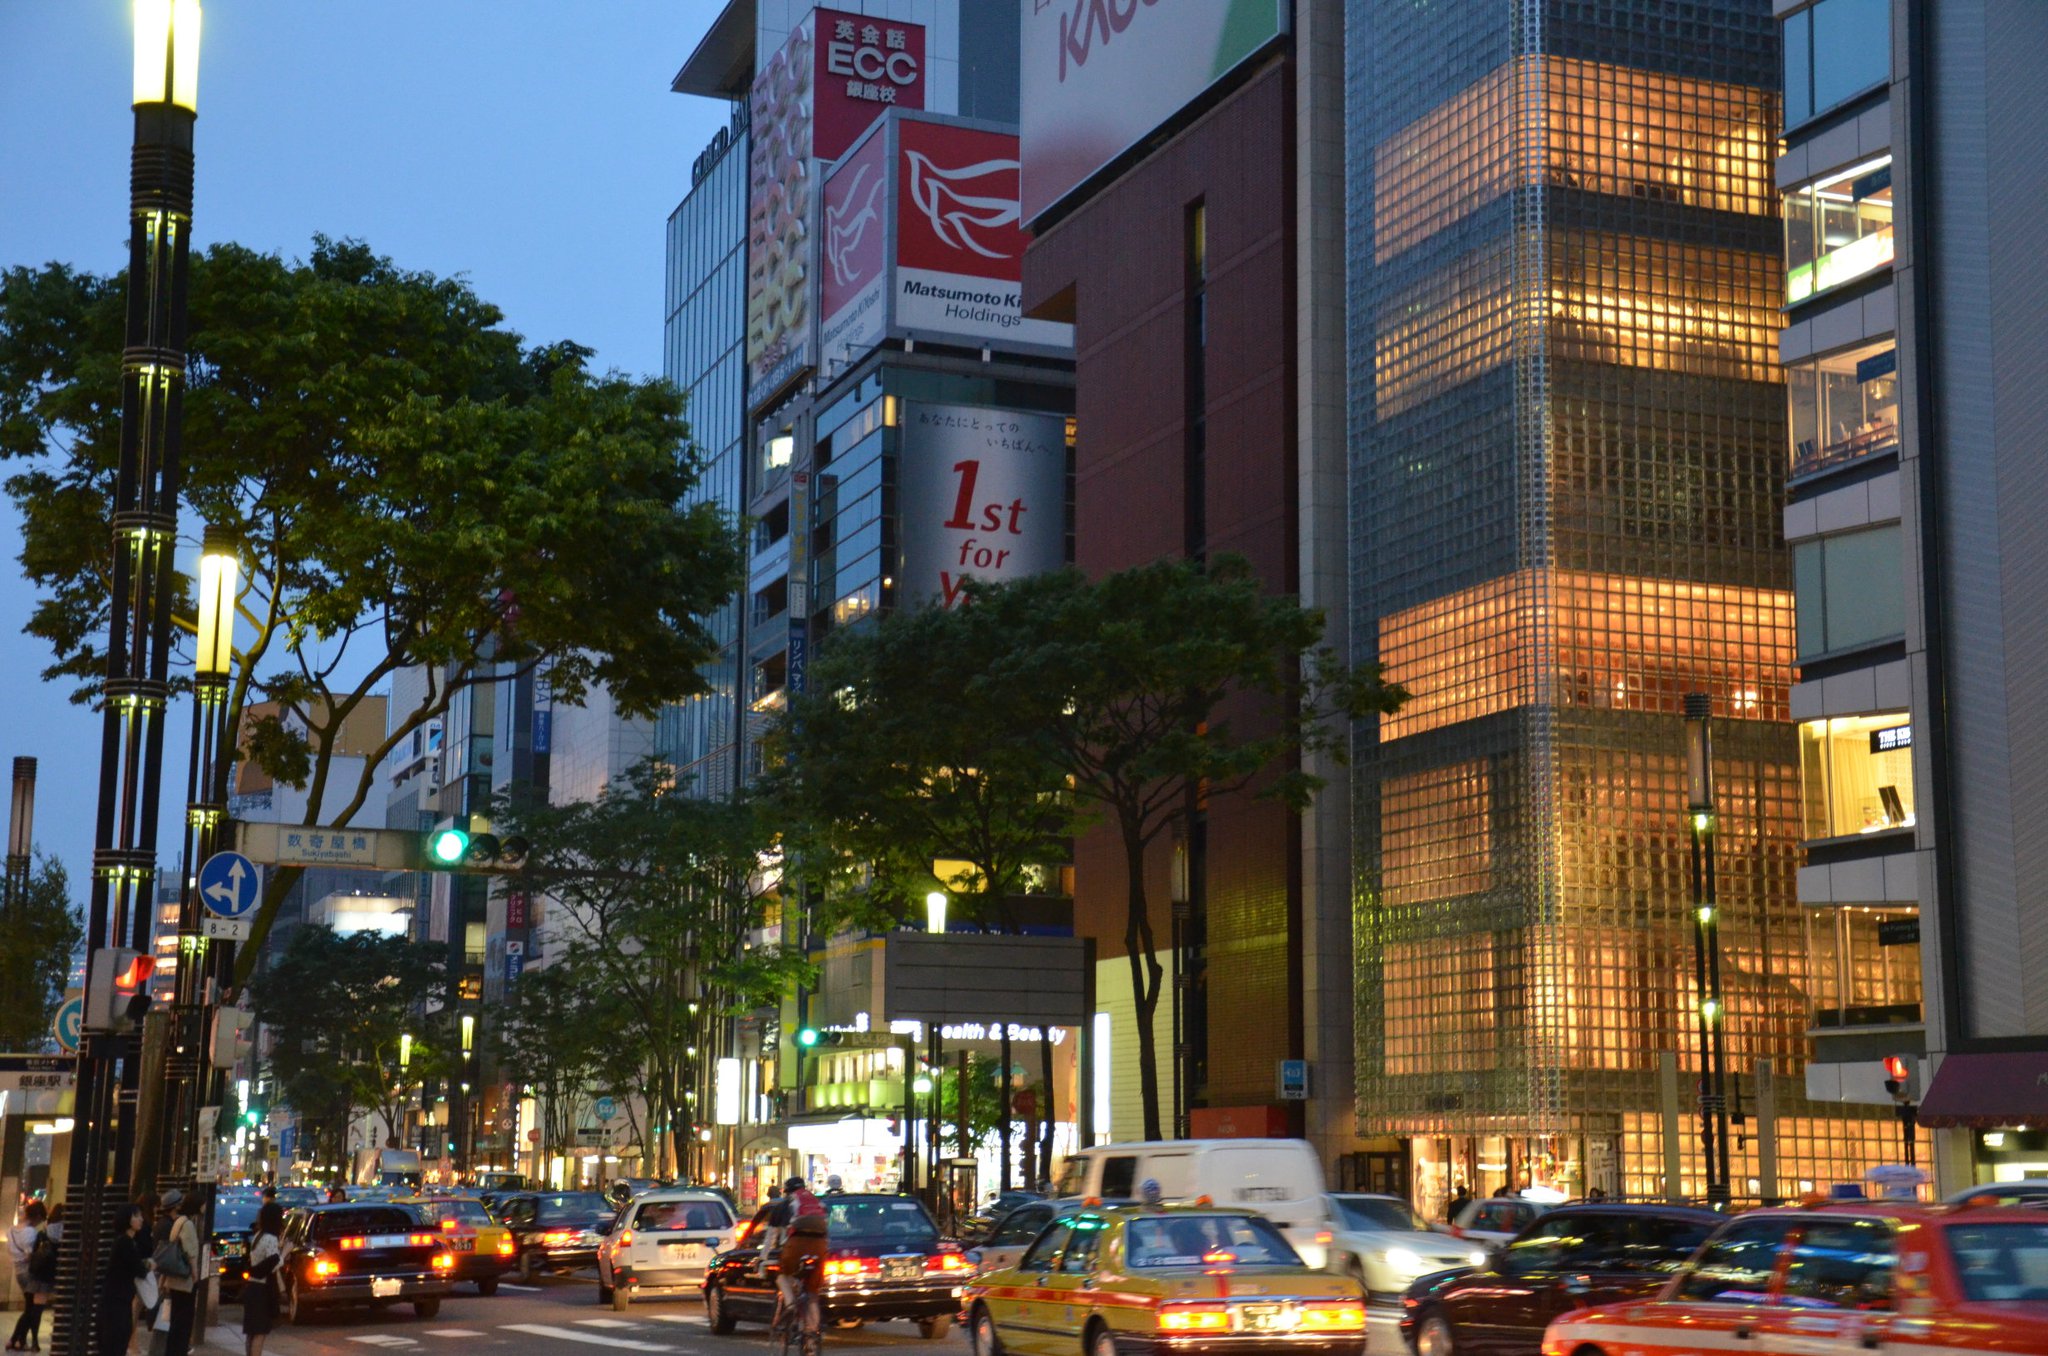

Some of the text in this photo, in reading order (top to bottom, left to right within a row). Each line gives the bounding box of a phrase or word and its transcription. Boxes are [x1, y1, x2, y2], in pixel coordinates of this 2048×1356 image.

[828, 40, 917, 85] ECC
[903, 280, 1002, 307] Matsumoto
[945, 303, 1021, 328] Holdings
[919, 413, 1020, 433] あなたにとっての
[943, 459, 1028, 535] 1st
[959, 538, 1010, 569] for
[302, 848, 352, 859] Sukiyabashi
[940, 1022, 985, 1040] ealth
[988, 1022, 1002, 1041] &
[1008, 1023, 1066, 1046] Beaty
